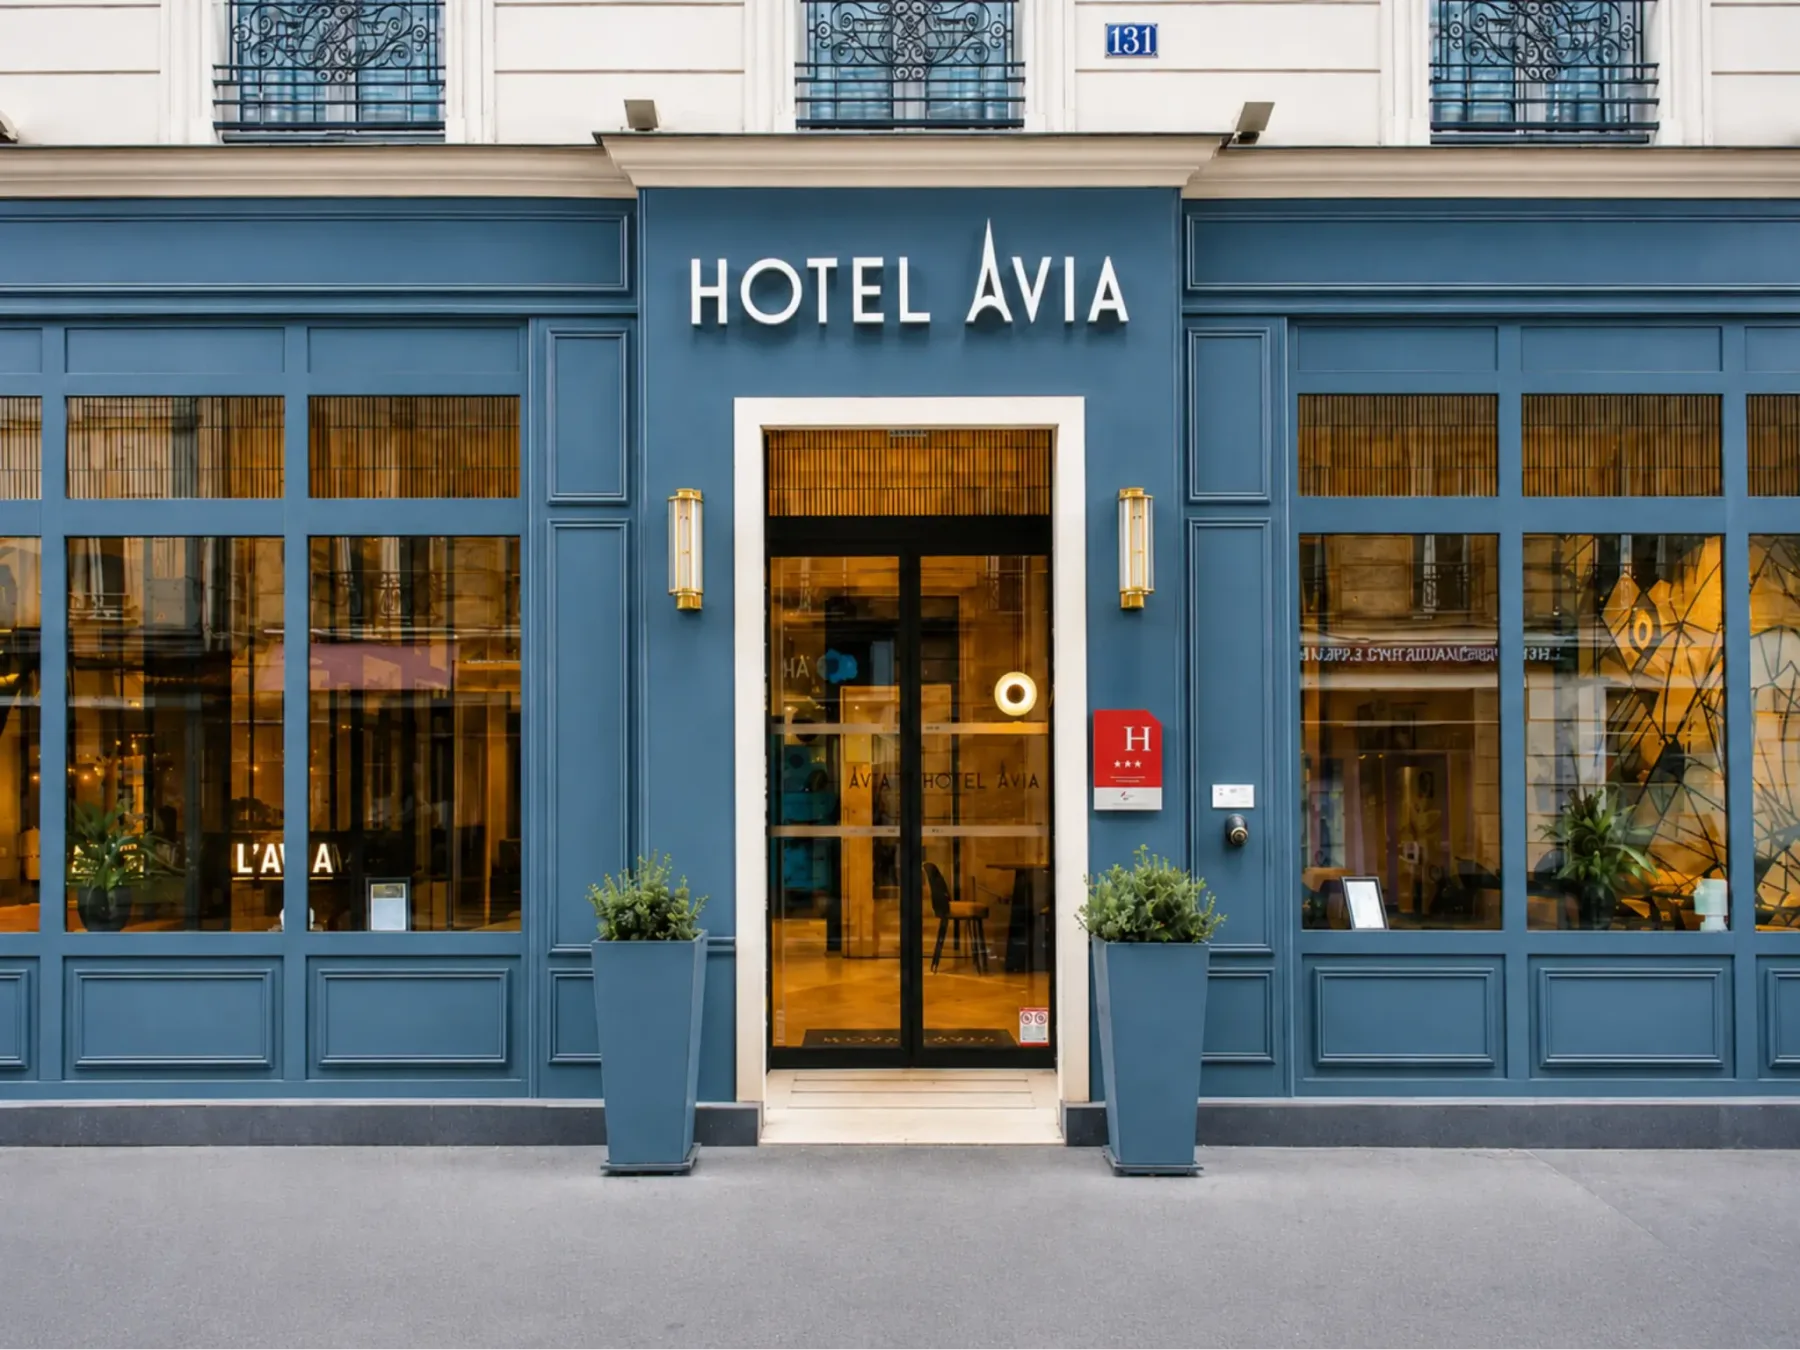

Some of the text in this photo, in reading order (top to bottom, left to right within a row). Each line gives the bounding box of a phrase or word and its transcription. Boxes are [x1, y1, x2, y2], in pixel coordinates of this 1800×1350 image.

[1110, 26, 1152, 54] 131
[690, 218, 1129, 325] HOTEL AVIA
[1124, 726, 1152, 751] H
[848, 766, 891, 790] AVA
[997, 760, 1040, 789] AVIA
[236, 843, 334, 874] L'AA
